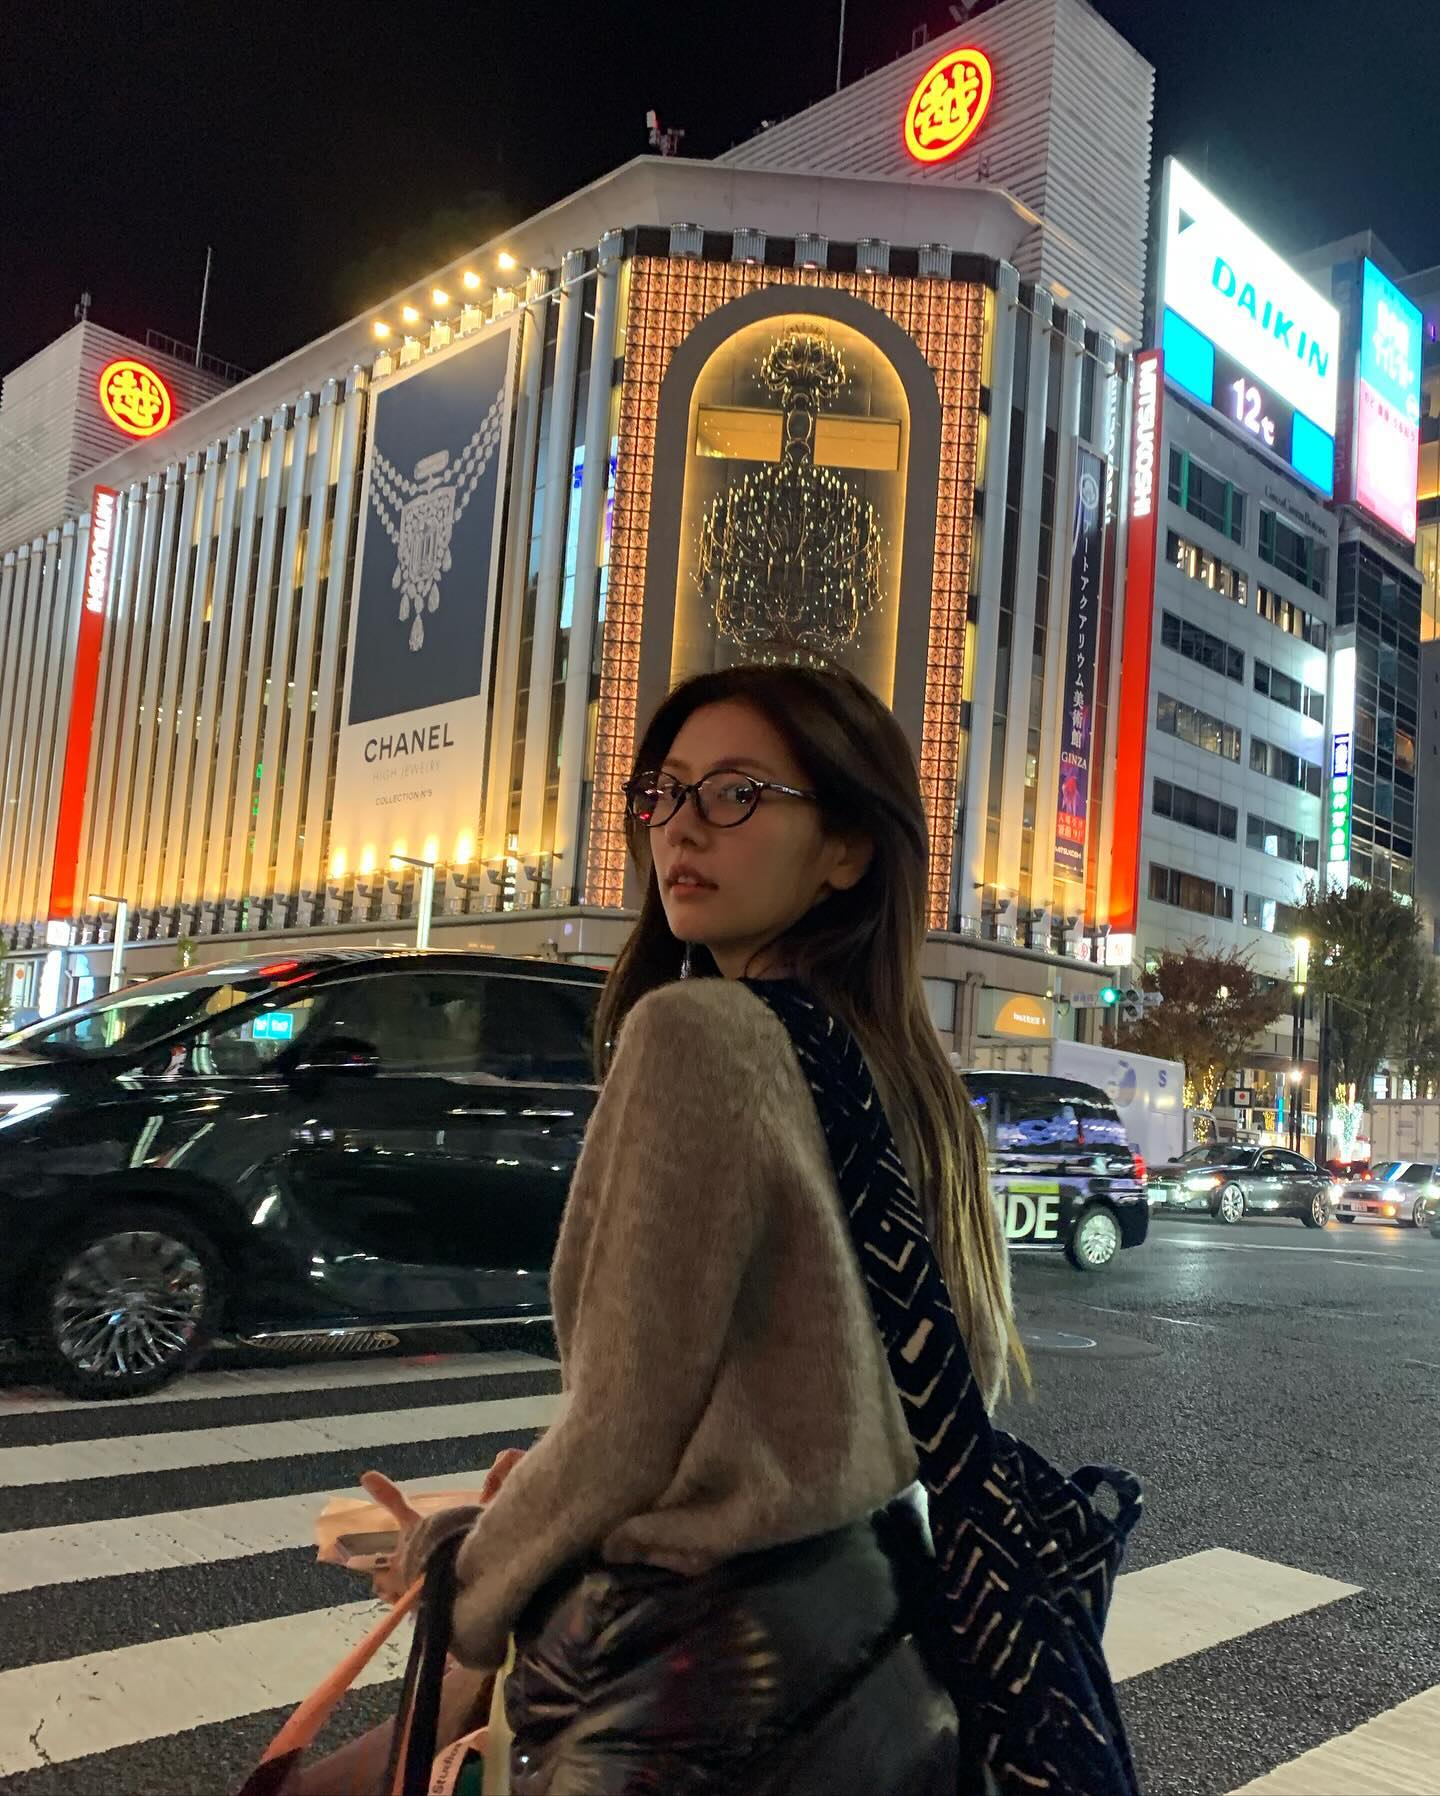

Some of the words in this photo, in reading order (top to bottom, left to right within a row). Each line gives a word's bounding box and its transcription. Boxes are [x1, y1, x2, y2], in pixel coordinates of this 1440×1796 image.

[1212, 256, 1328, 377] DAIKIN
[1133, 358, 1158, 517] MITSUKOSHI
[364, 721, 455, 763] CHANEL
[1061, 752, 1087, 769] GINZA
[1158, 1069, 1167, 1088] S
